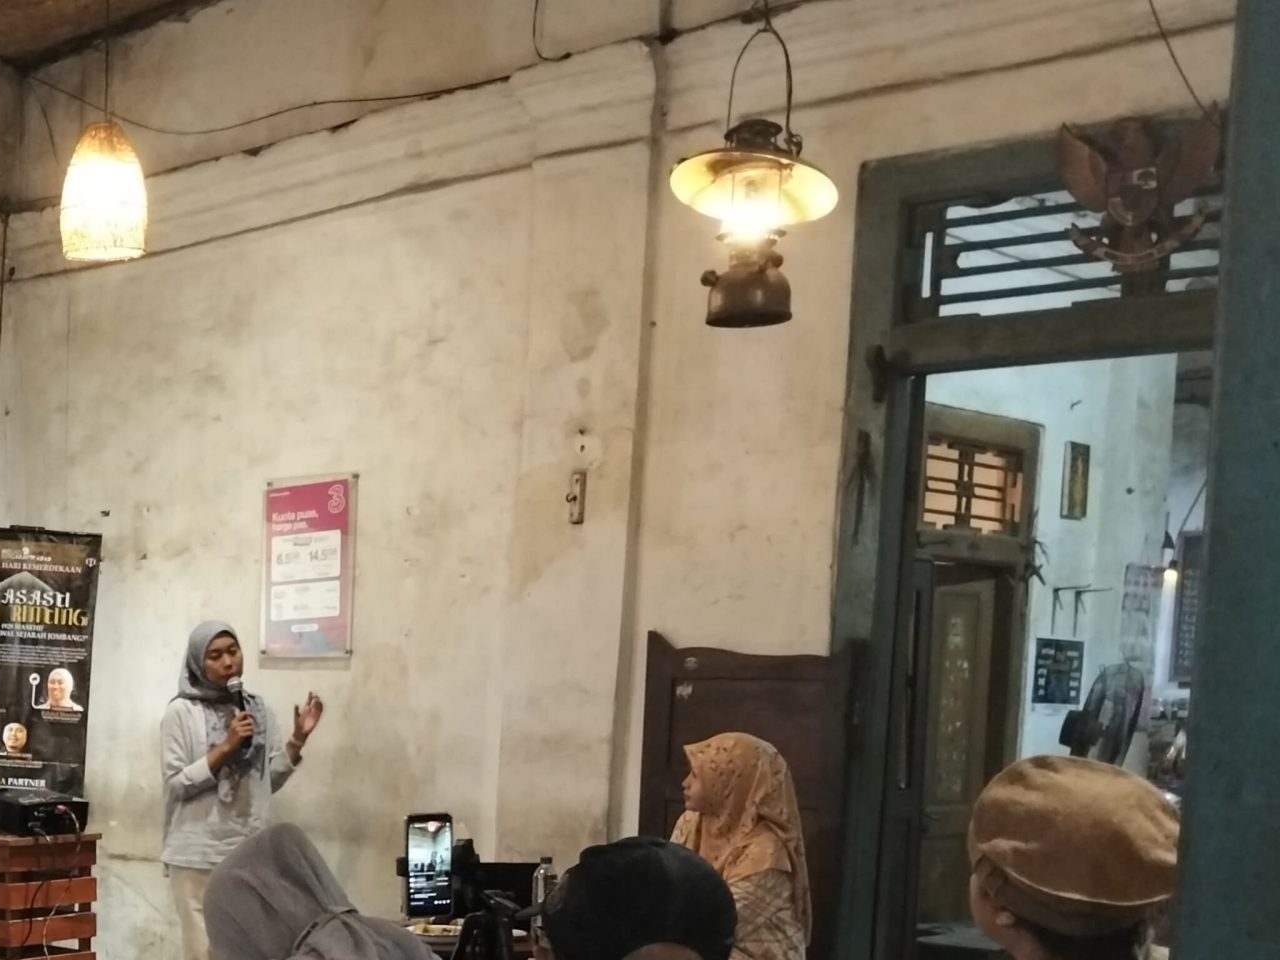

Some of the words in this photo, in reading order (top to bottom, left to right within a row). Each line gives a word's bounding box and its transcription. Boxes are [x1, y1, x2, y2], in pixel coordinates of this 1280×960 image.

[328, 484, 346, 514] 3
[272, 512, 296, 522] Kuota
[2, 562, 22, 571] HARI
[23, 563, 82, 573] KEMERDEKAAN
[11, 606, 88, 626] RINTING
[15, 630, 46, 639] SEJARAH
[7, 778, 46, 788] PARTNER
